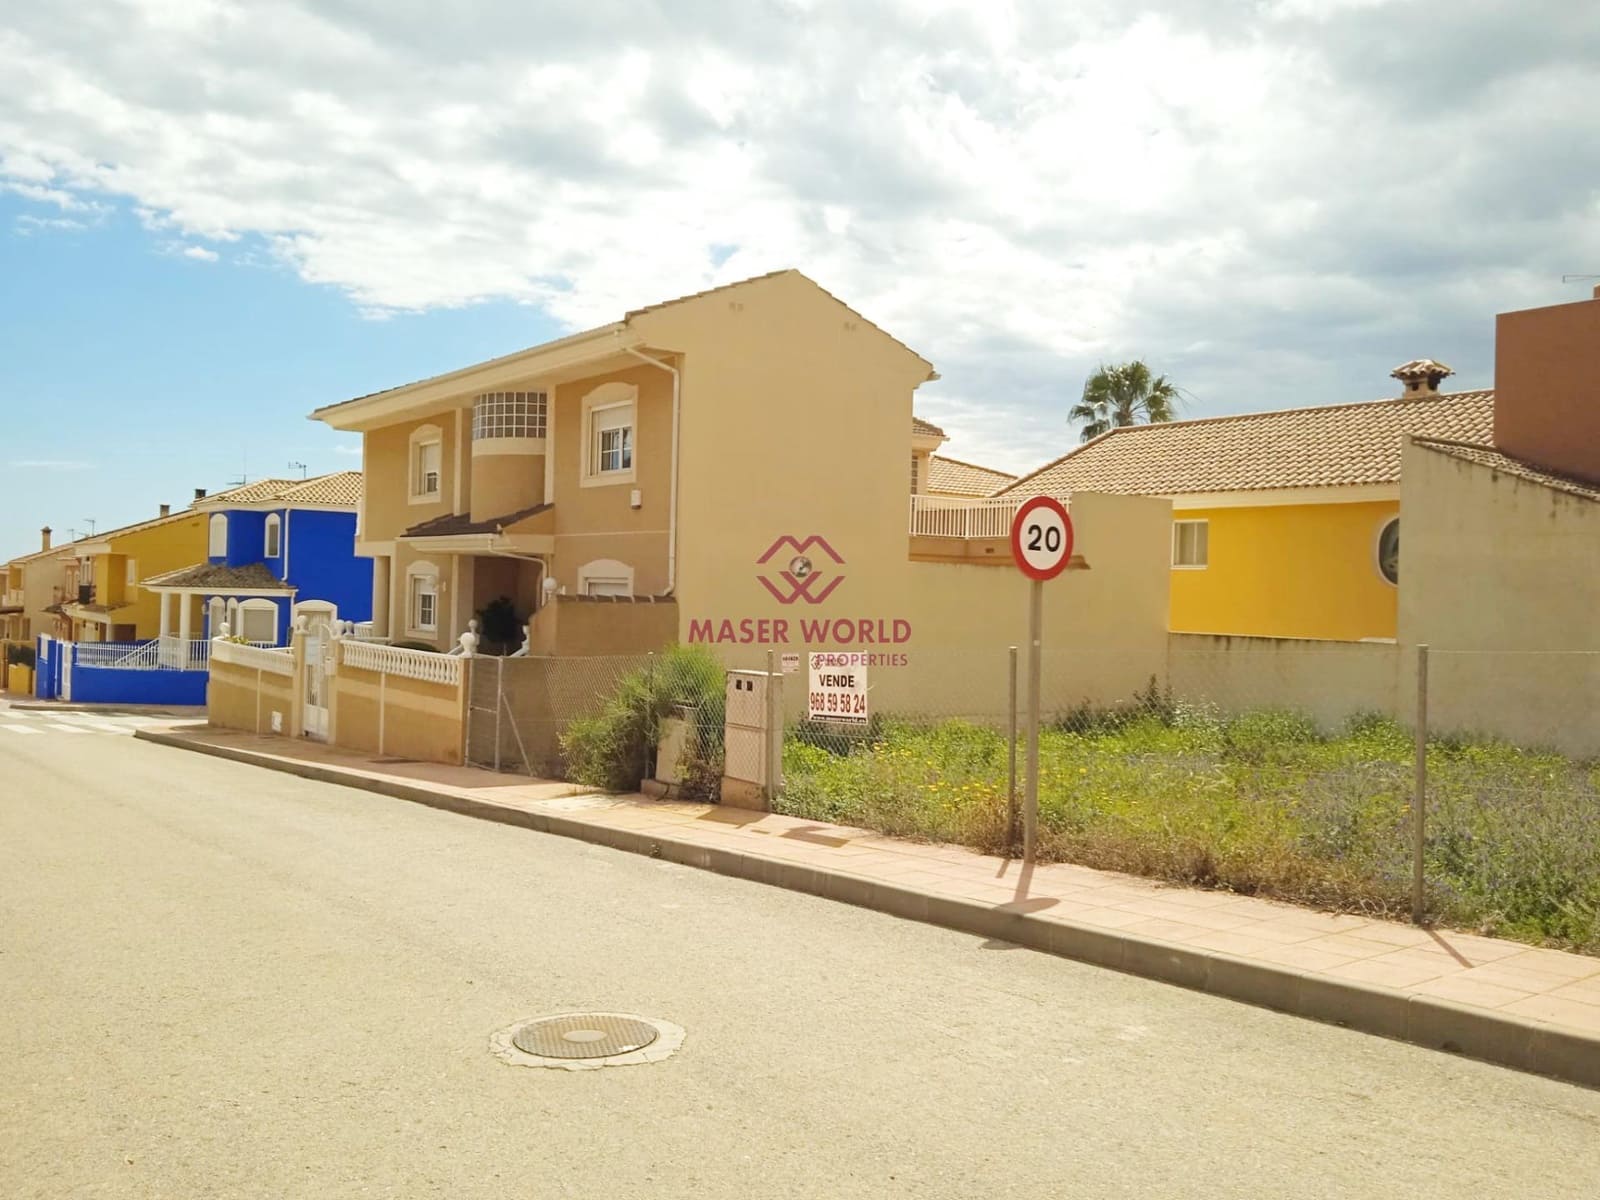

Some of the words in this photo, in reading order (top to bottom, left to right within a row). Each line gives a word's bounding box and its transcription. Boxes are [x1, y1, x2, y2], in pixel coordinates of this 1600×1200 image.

[1028, 525, 1060, 552] 20
[819, 675, 855, 688] VENDE
[810, 692, 825, 711] 968
[827, 693, 838, 712] 59
[840, 694, 851, 713] 58
[853, 694, 865, 714] 24
